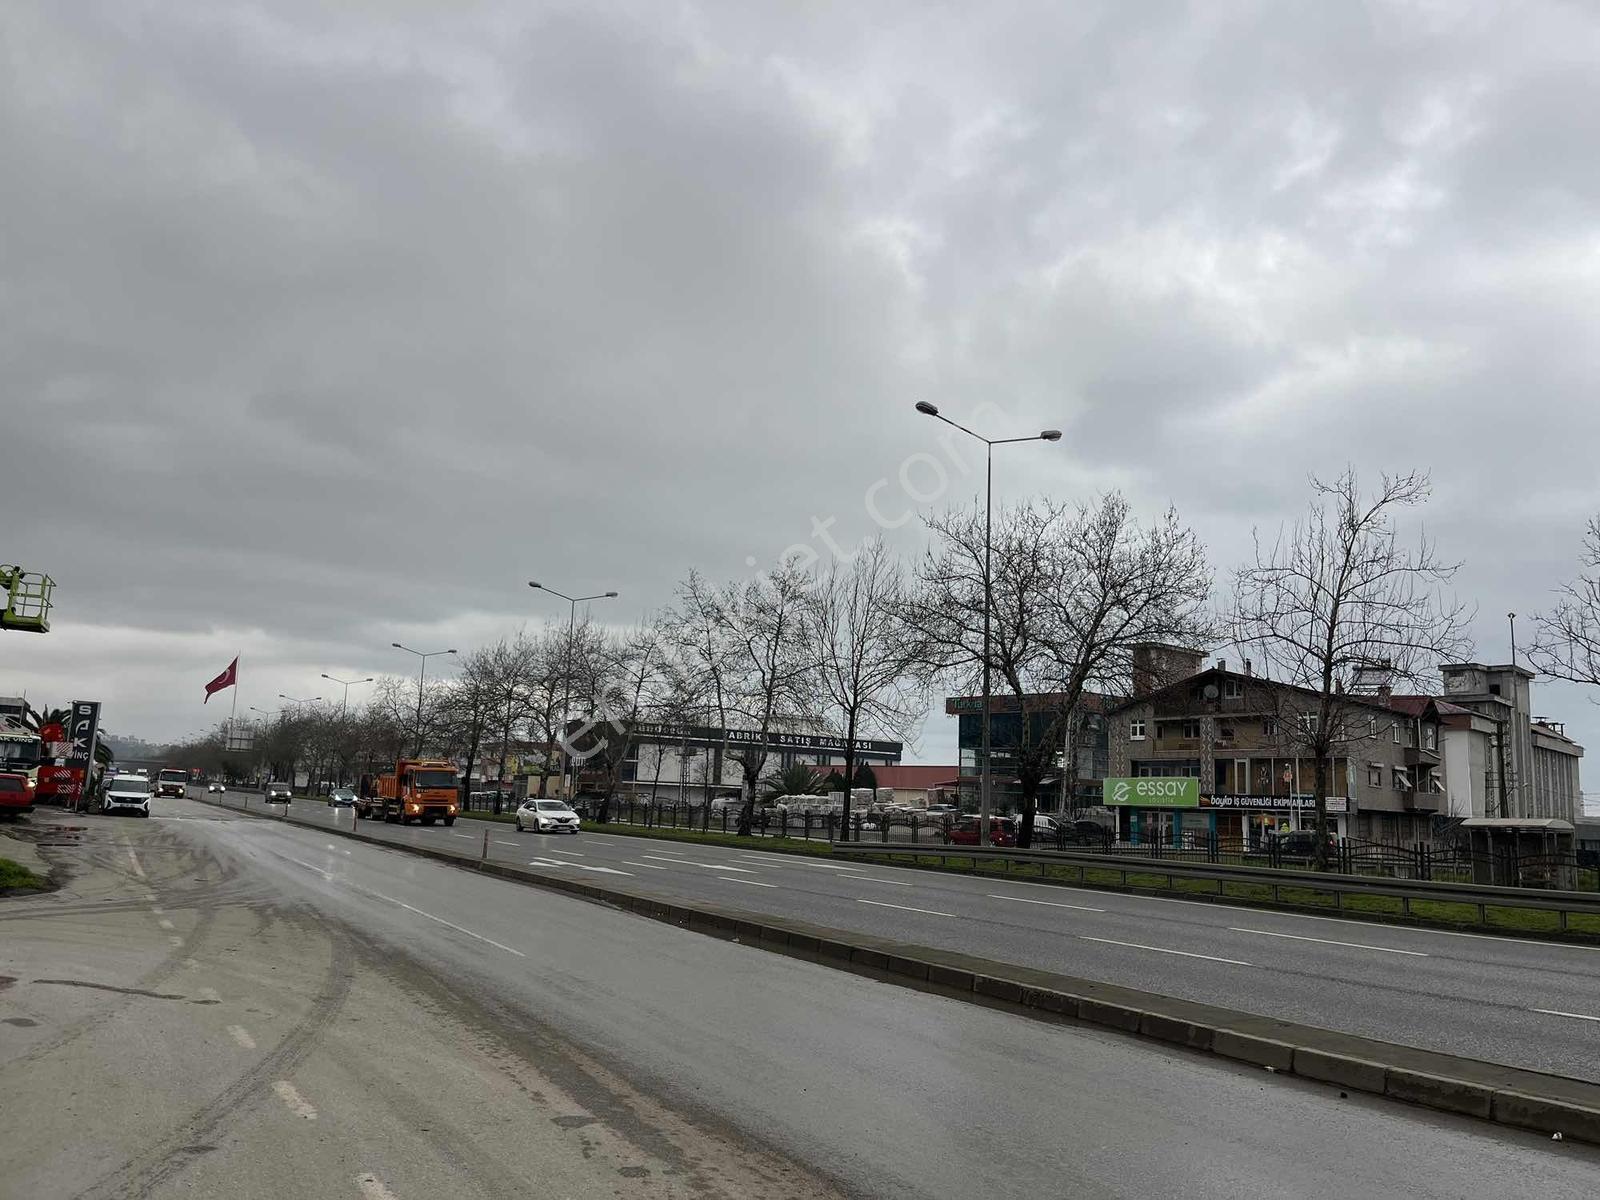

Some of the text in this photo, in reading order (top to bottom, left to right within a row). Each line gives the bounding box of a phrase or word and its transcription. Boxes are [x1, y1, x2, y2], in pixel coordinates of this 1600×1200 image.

[724, 731, 872, 750] ABRİK SATIŞ MAĞAASI
[1136, 781, 1188, 797] essay
